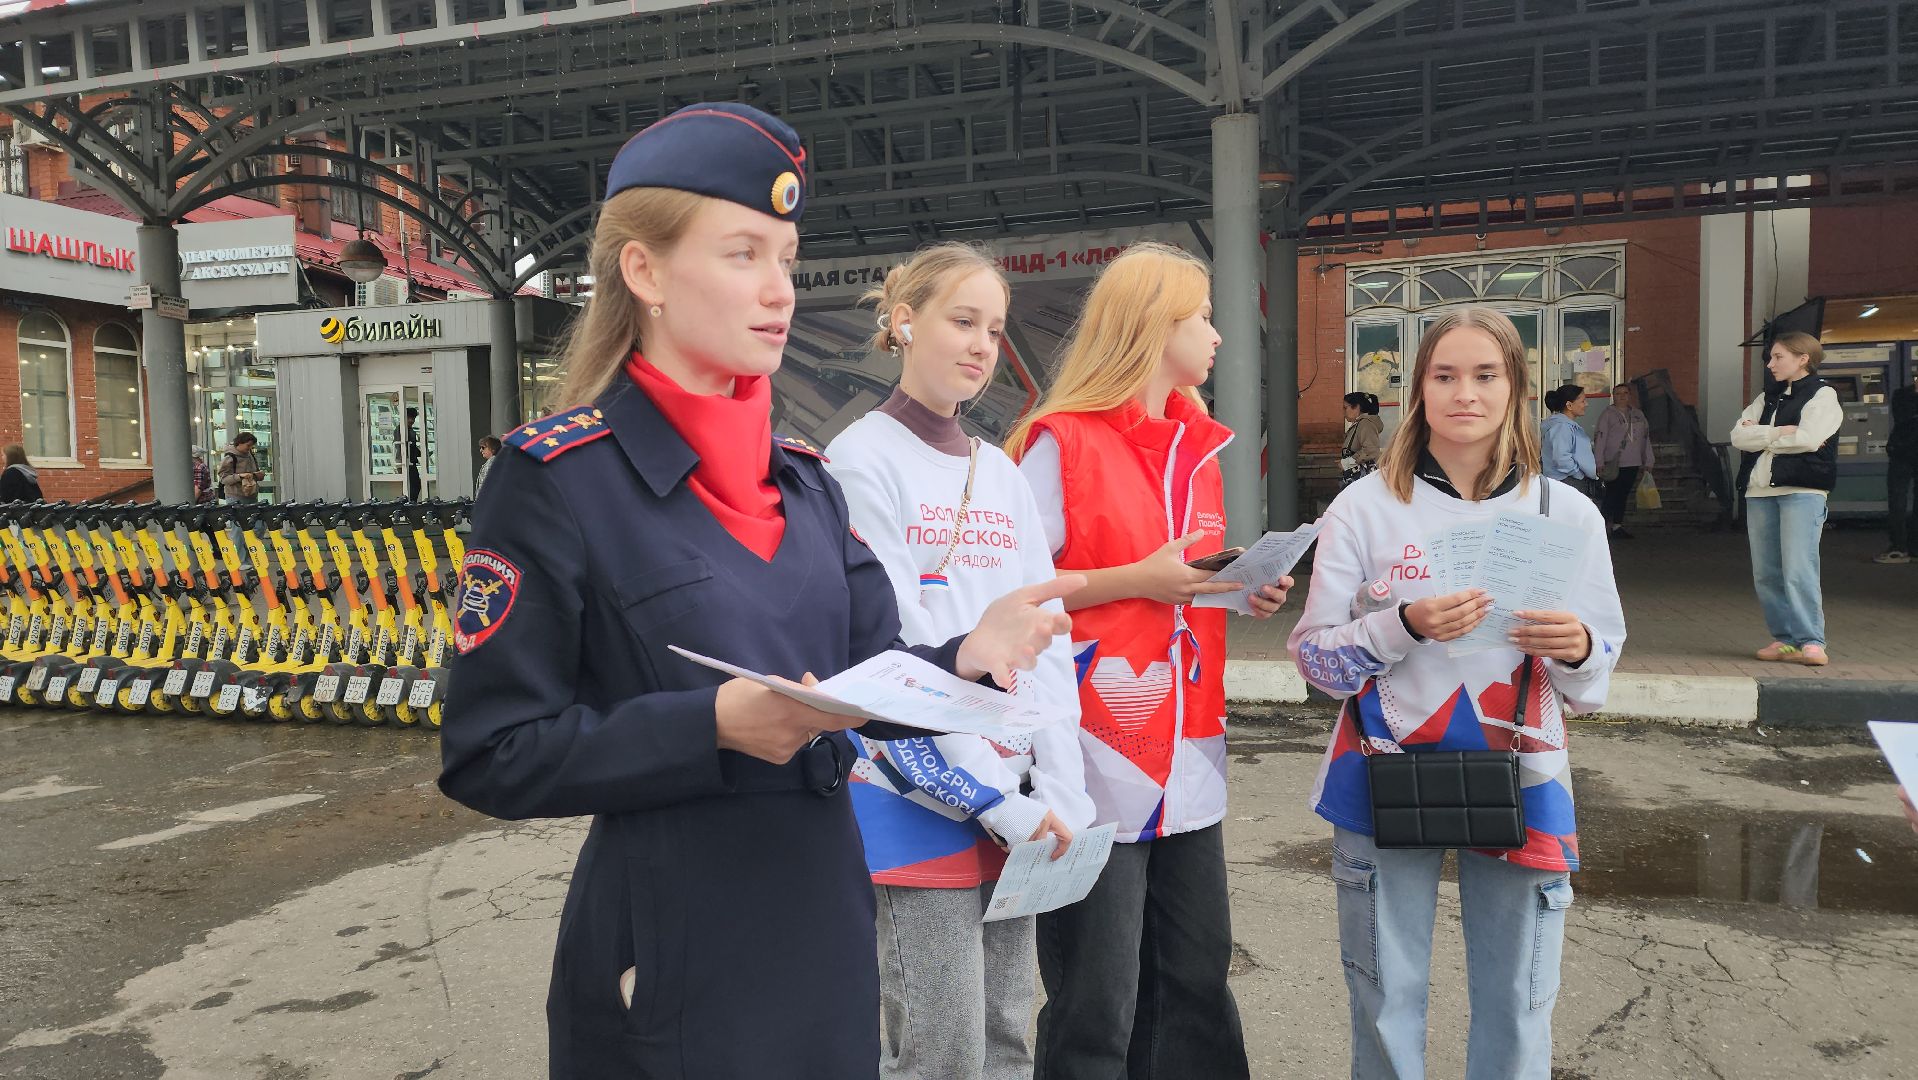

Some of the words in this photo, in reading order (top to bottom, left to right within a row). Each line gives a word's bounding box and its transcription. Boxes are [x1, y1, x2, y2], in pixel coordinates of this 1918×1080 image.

[6, 227, 136, 273] ШАШЛЫК
[185, 244, 293, 263] ПАРФЮМЕРИЯ
[191, 261, 290, 280] АКСЕССУАРЫ
[793, 270, 840, 291] ЩАЯ
[844, 266, 891, 285] СТА
[345, 313, 441, 341] билайн
[413, 681, 433, 693] HC5
